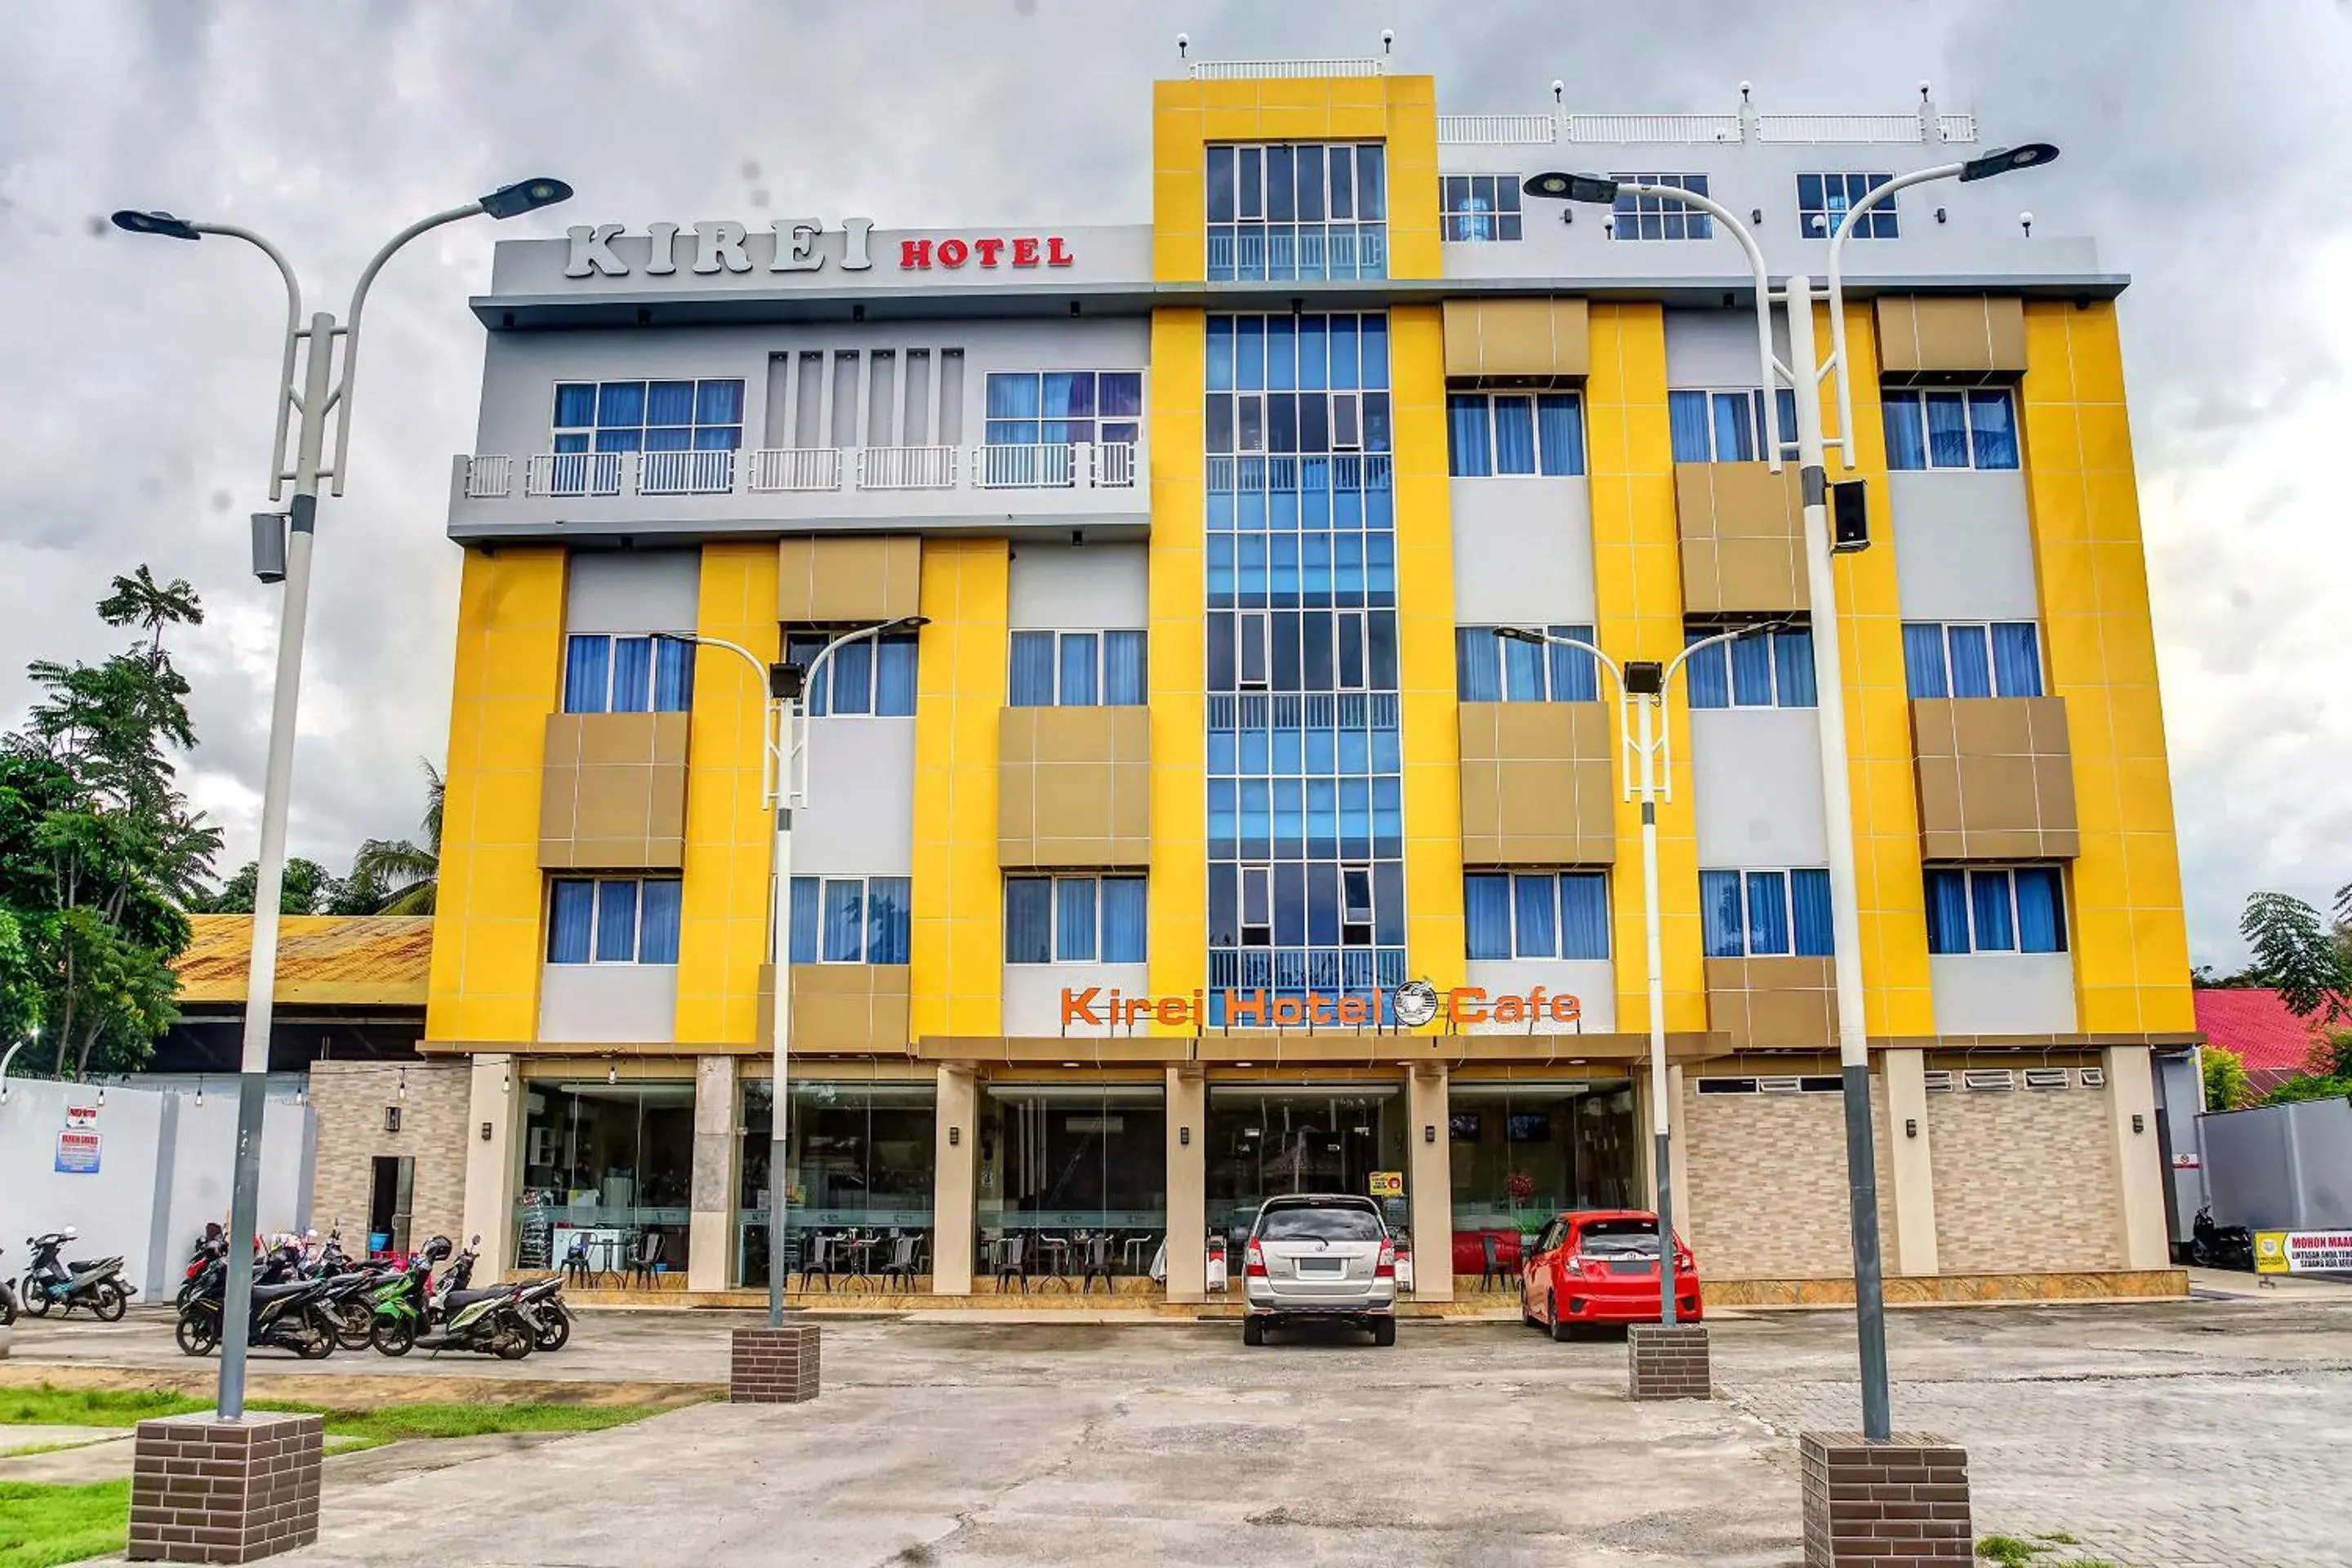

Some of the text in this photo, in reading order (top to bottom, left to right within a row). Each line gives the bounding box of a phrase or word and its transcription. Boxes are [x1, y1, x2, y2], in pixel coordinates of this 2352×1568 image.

[564, 217, 1074, 278] KIREI HOTEL
[1061, 986, 1581, 1026] Kirei Hotel Cafe
[2292, 1236, 2326, 1249] MOHON
